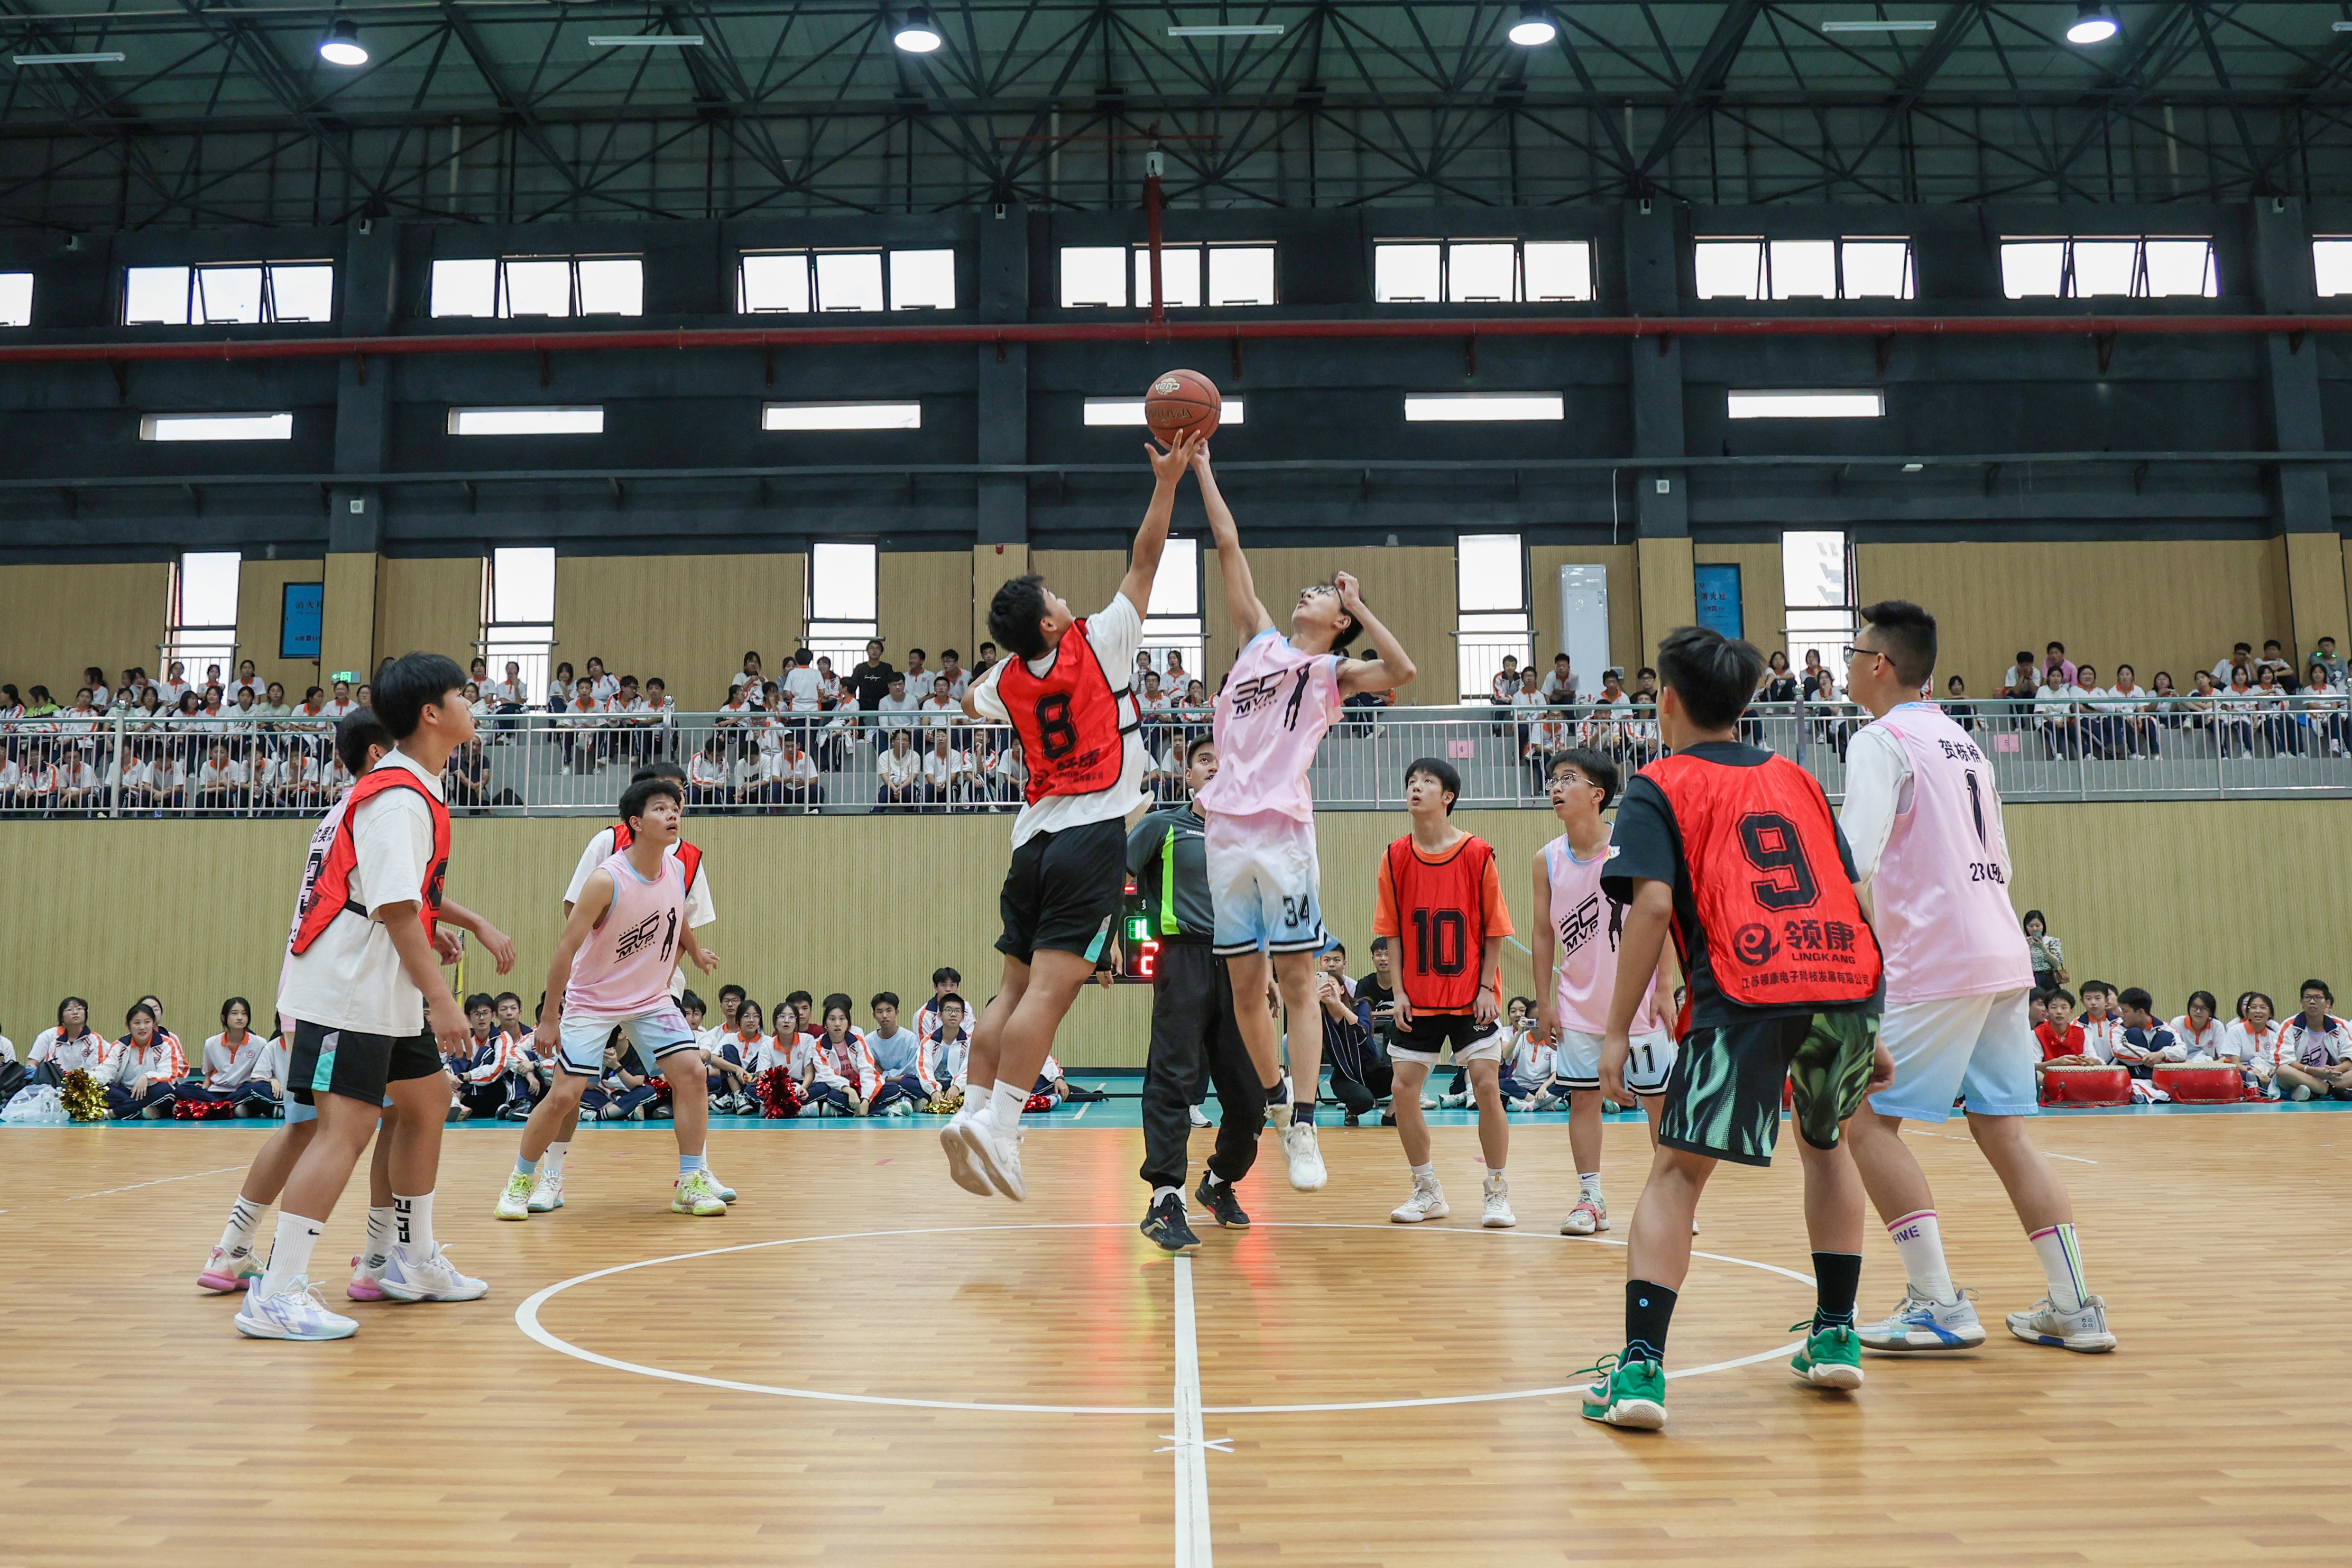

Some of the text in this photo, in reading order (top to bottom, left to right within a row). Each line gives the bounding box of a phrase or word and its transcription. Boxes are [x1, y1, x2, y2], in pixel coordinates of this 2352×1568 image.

[1033, 690, 1080, 764] 8
[1964, 769, 1986, 854] 1
[1736, 810, 1822, 913] 9
[1282, 893, 1310, 929] 34
[618, 934, 654, 959] MVP
[1411, 907, 1467, 977] 10
[1566, 919, 1598, 953] MVP
[1785, 919, 1856, 953] 领康
[1792, 953, 1856, 965] LINGKANG
[1629, 1043, 1656, 1075] 11
